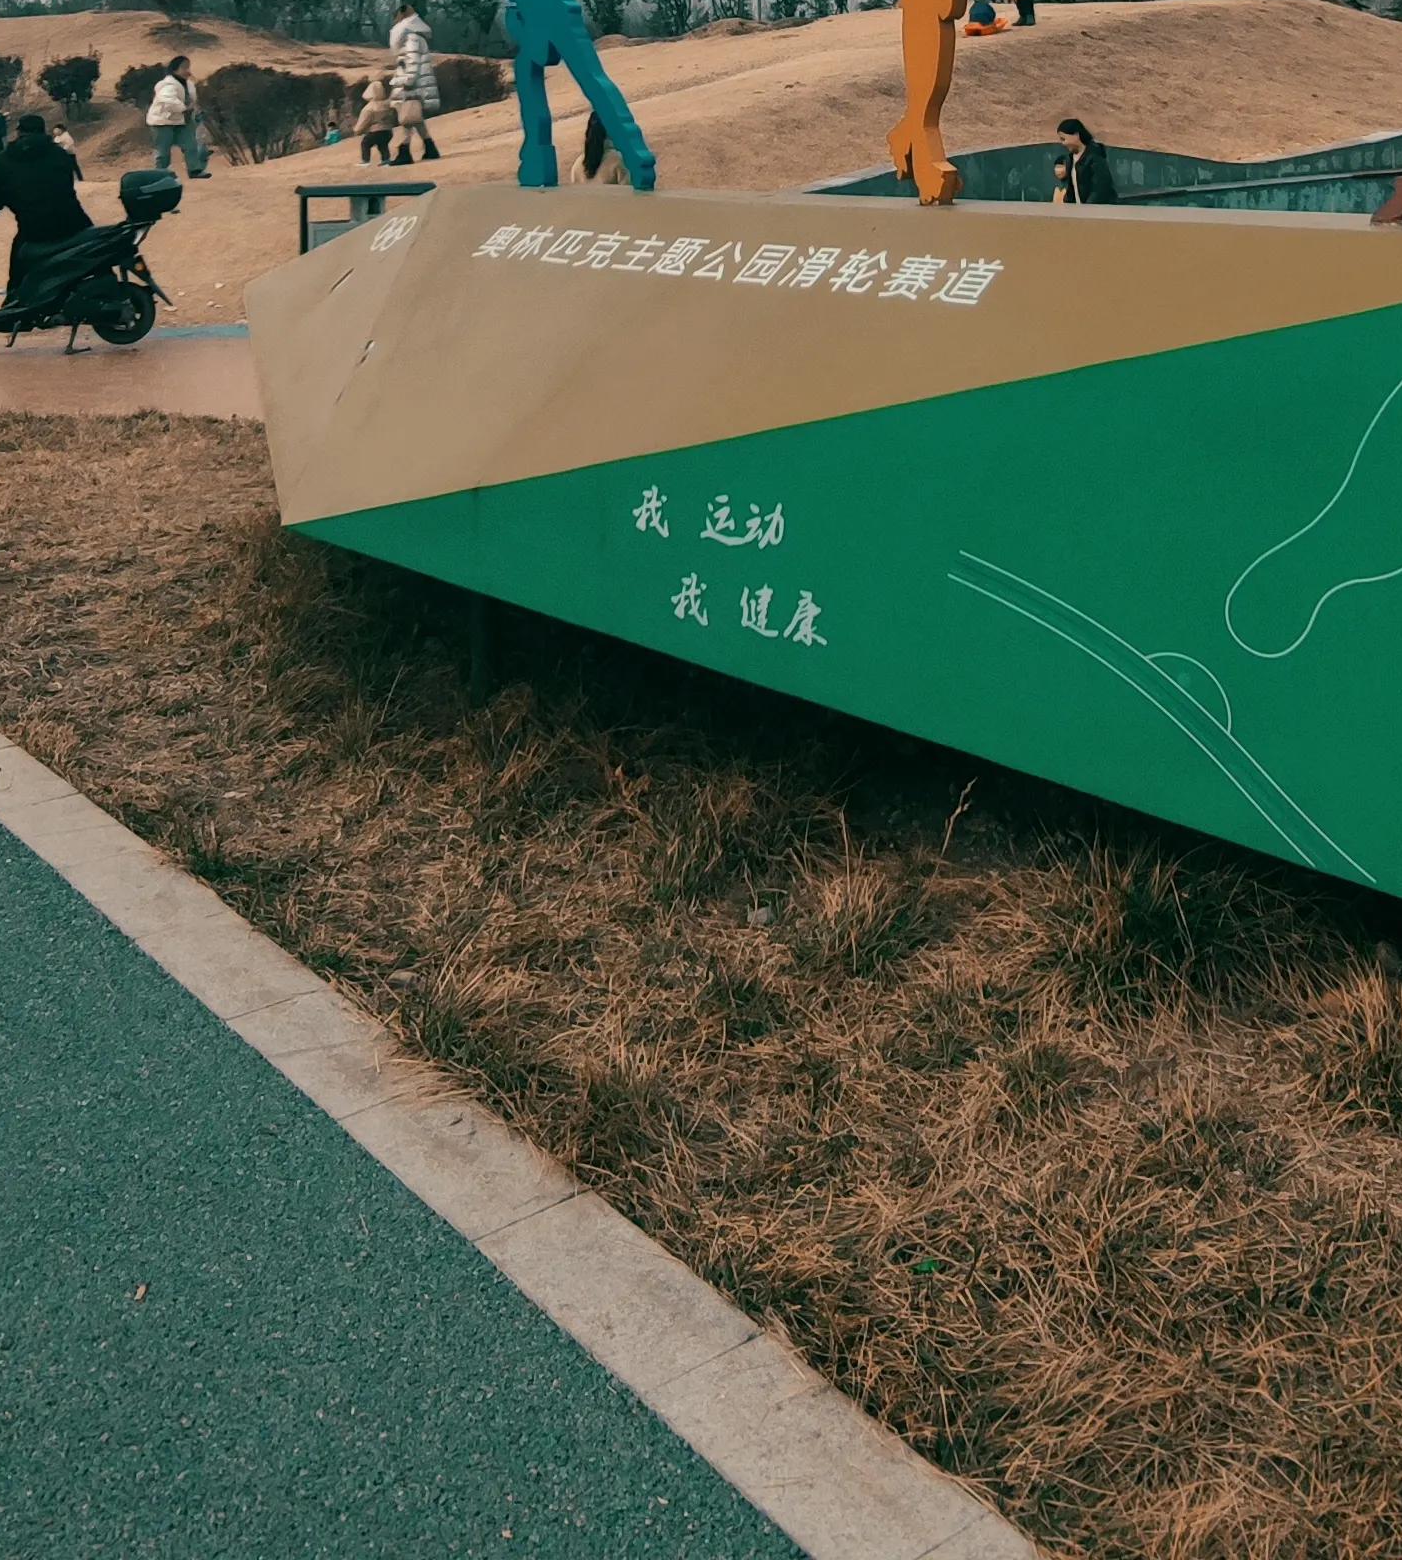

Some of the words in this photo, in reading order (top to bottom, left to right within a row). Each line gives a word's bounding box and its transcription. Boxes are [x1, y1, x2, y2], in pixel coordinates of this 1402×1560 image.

[471, 223, 1005, 306] 奥林匹克主题公园滑轮赛道
[632, 484, 669, 538] 我
[700, 494, 785, 550] 运动
[670, 572, 709, 626] 我
[740, 583, 828, 646] 健康
